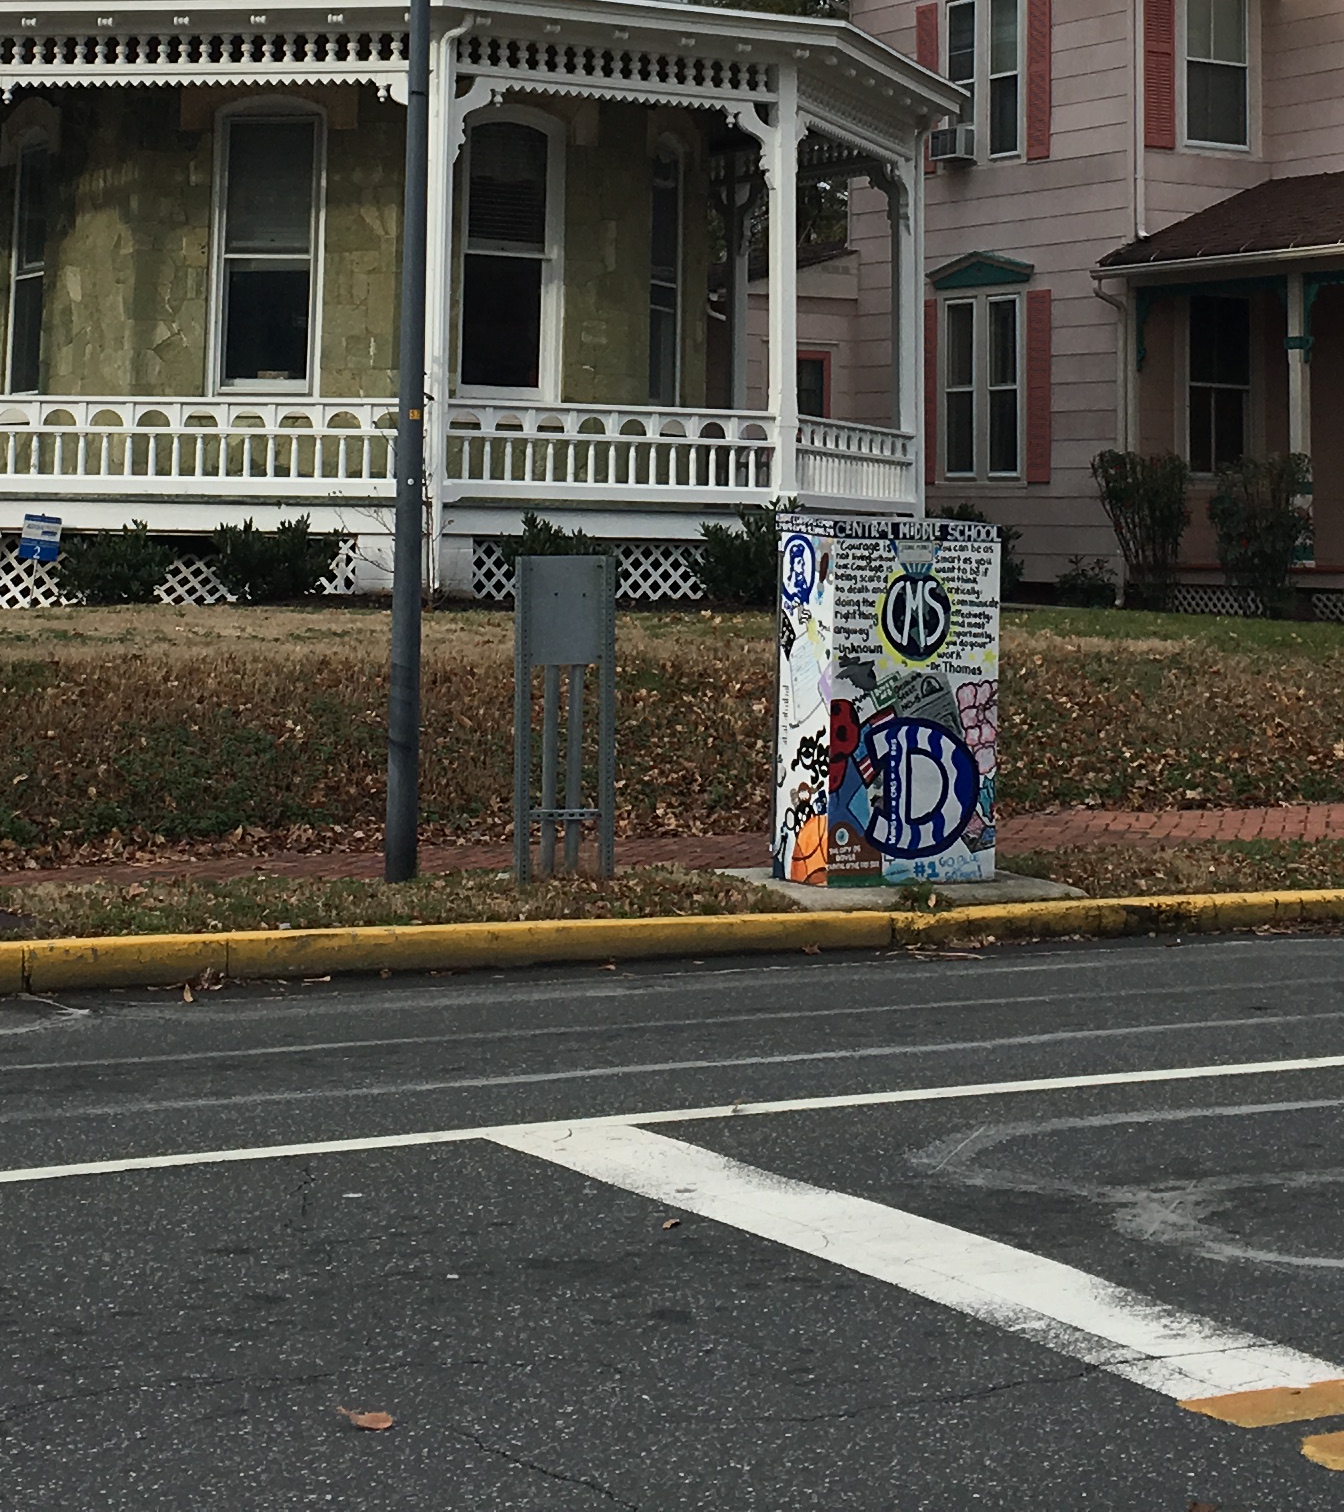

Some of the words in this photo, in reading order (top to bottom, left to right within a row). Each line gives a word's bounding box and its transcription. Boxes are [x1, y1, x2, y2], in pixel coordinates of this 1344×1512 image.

[835, 520, 894, 539] CENTRAL
[947, 524, 1002, 542] SCHOOL
[32, 545, 41, 559] 2
[883, 541, 892, 553] is
[952, 544, 969, 552] can
[970, 543, 982, 553] be
[982, 545, 994, 554] as
[956, 565, 968, 575] to
[962, 556, 973, 565] as
[974, 557, 993, 570] you
[834, 596, 860, 611] doing
[861, 597, 876, 608] the
[834, 609, 857, 623] right
[857, 610, 879, 627] thing
[886, 580, 945, 649] CMS
[941, 660, 983, 676] Thomas
[913, 860, 940, 879] #1
